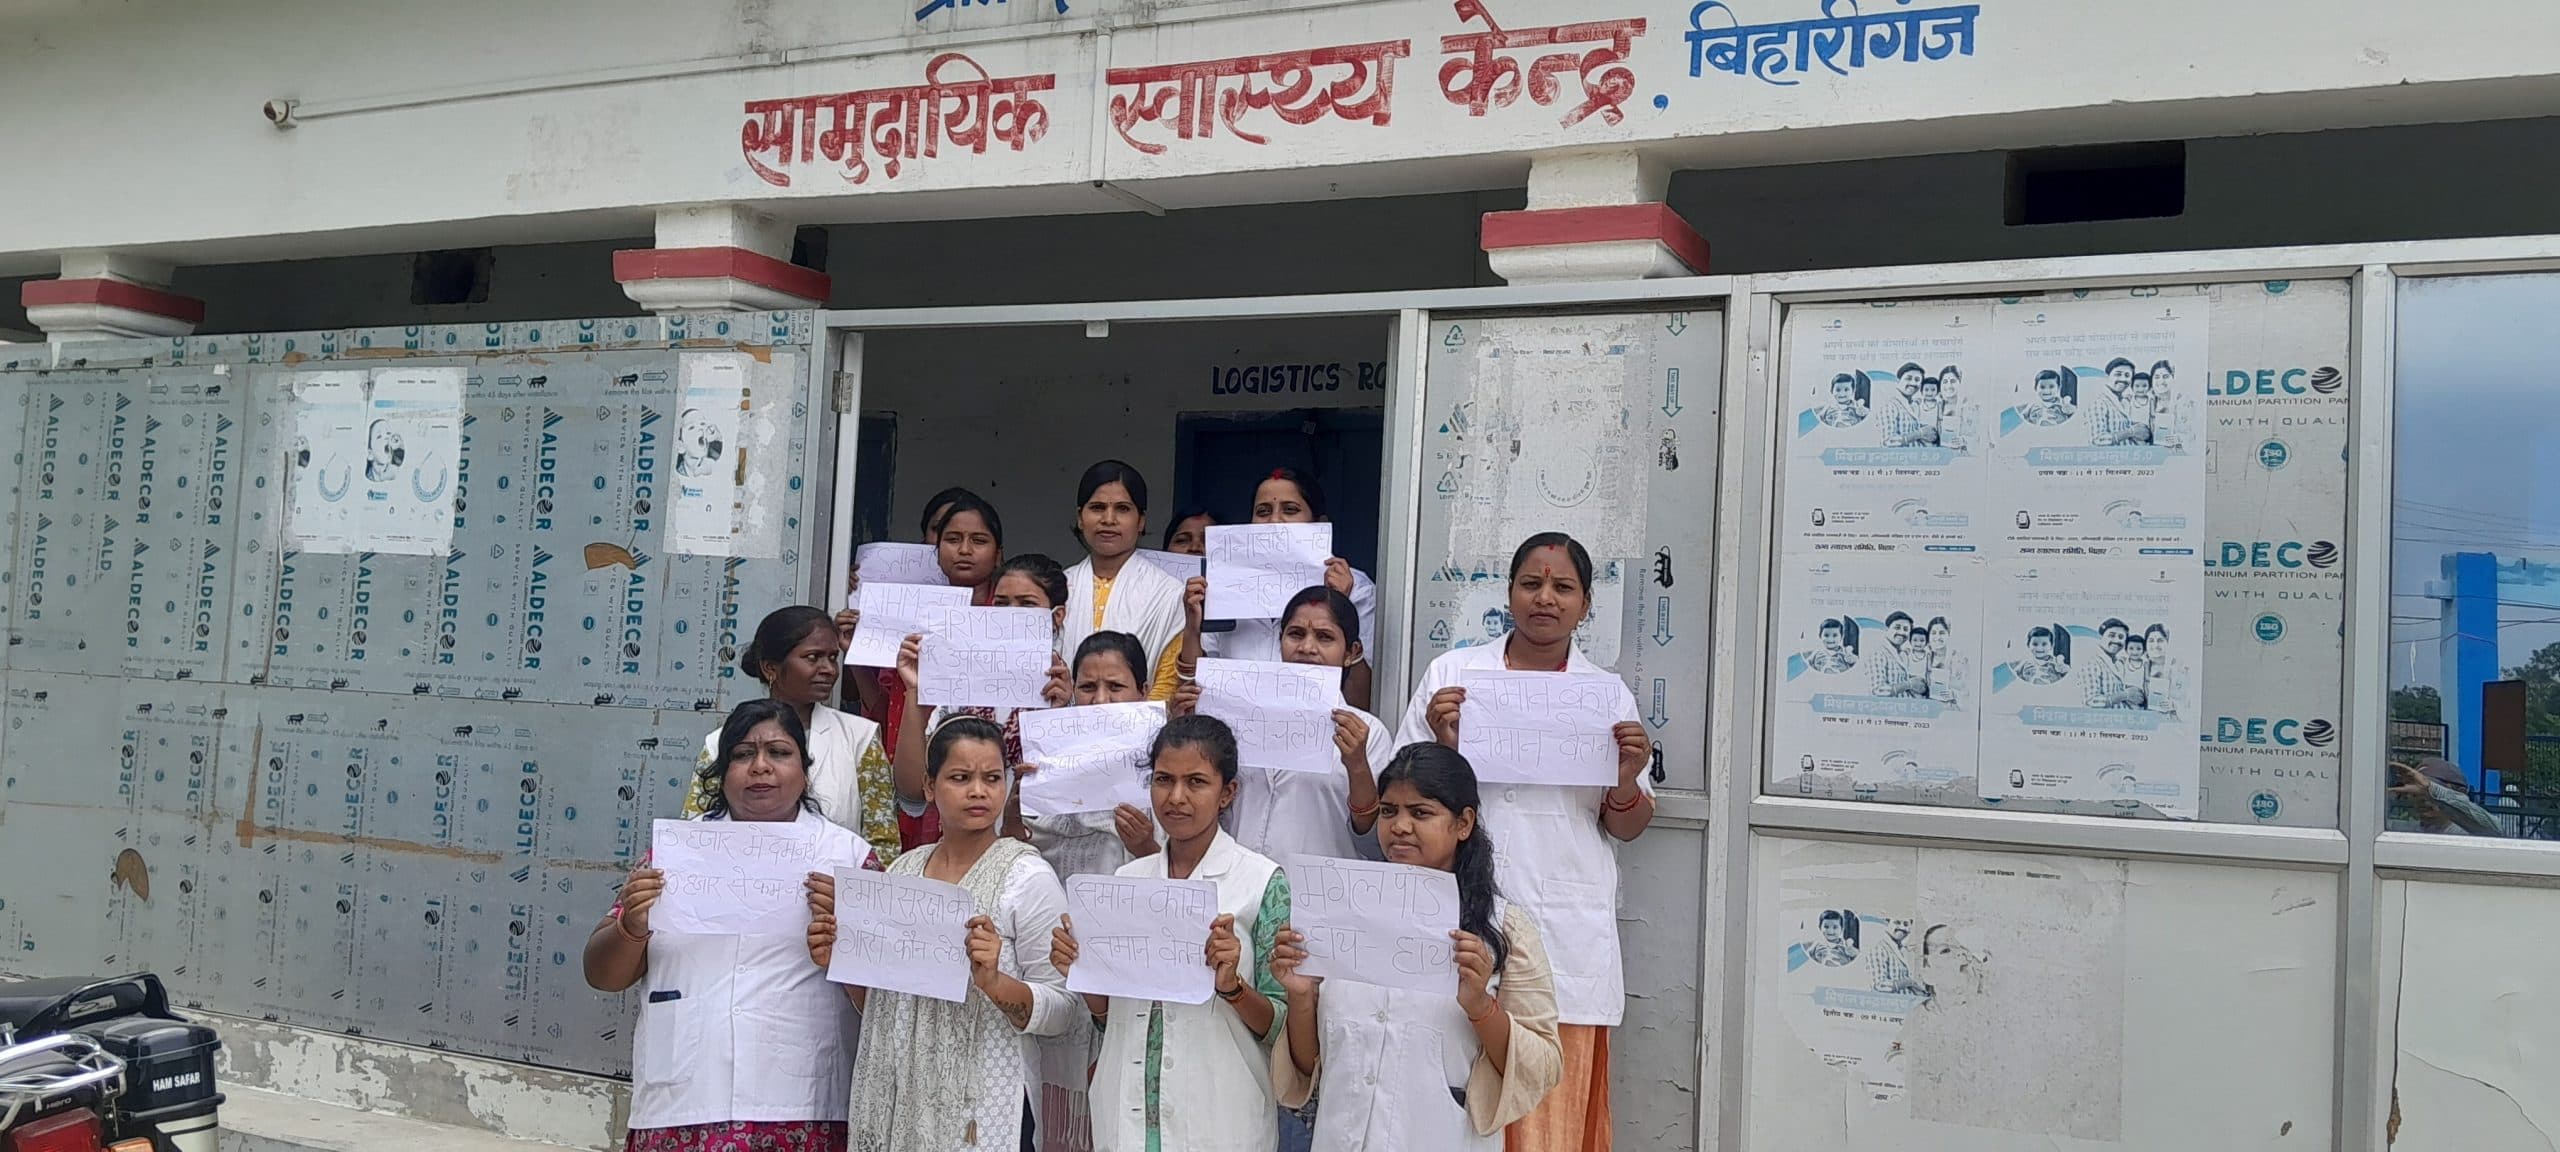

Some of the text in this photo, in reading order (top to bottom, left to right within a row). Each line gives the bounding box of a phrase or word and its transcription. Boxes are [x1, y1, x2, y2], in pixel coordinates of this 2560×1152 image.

[742, 53, 1056, 187] सामुदायिक
[1106, 38, 1411, 155] स्वास्थ्य
[1685, 0, 1980, 86] बिहारीगंज
[1212, 362, 1341, 395] LOGISTICS
[2219, 418, 2269, 426] WITH
[2253, 571, 2317, 579] PARTITION
[2216, 590, 2264, 600] WITH
[928, 609, 1003, 640] HRMS
[1632, 568, 1647, 695] Remove the film within 45 days
[2250, 748, 2313, 757] PARTITION
[2210, 765, 2261, 776] WITH
[1296, 858, 1387, 913] मंगल
[1074, 881, 1207, 927] समान काम
[1087, 926, 1205, 977] समान वेतन
[152, 1071, 201, 1092] HAM SAFAR
